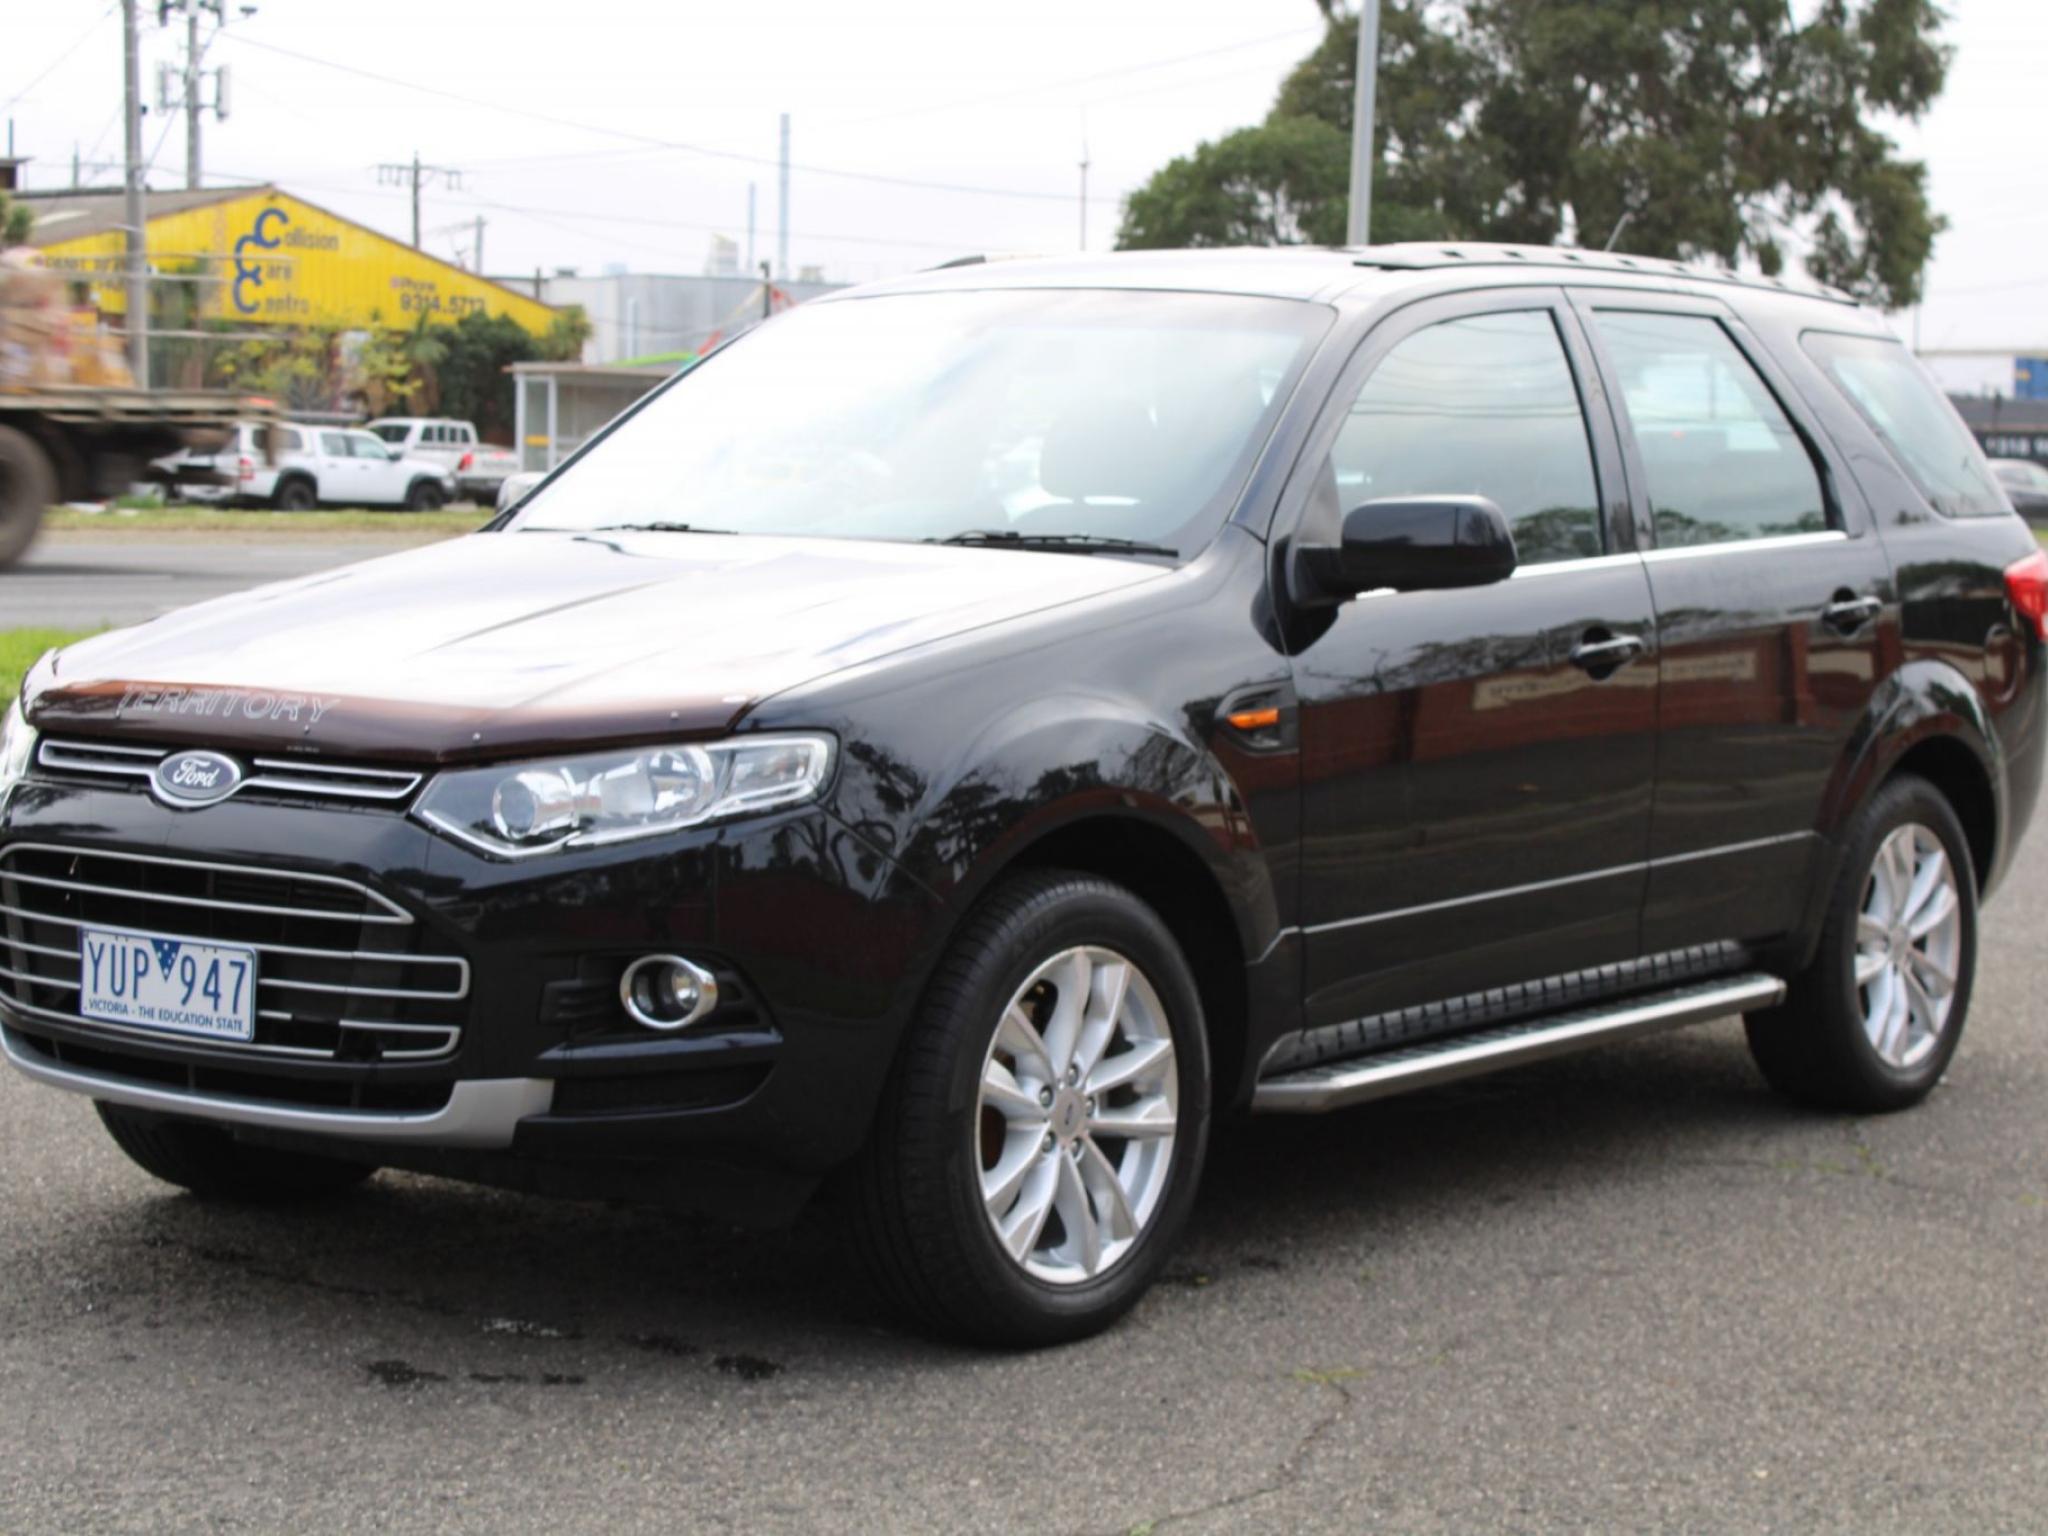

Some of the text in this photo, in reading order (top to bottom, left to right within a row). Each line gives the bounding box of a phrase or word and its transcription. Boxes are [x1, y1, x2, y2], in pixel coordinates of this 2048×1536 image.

[234, 235, 292, 279] Care
[116, 684, 340, 722] TERRITORY
[172, 758, 221, 788] Ford
[88, 941, 246, 1015] YUP 947
[89, 999, 128, 1015] VICTORIA
[139, 1005, 155, 1020] THE
[158, 1009, 213, 1028] EDUCATION
[216, 1018, 243, 1032] STATE
